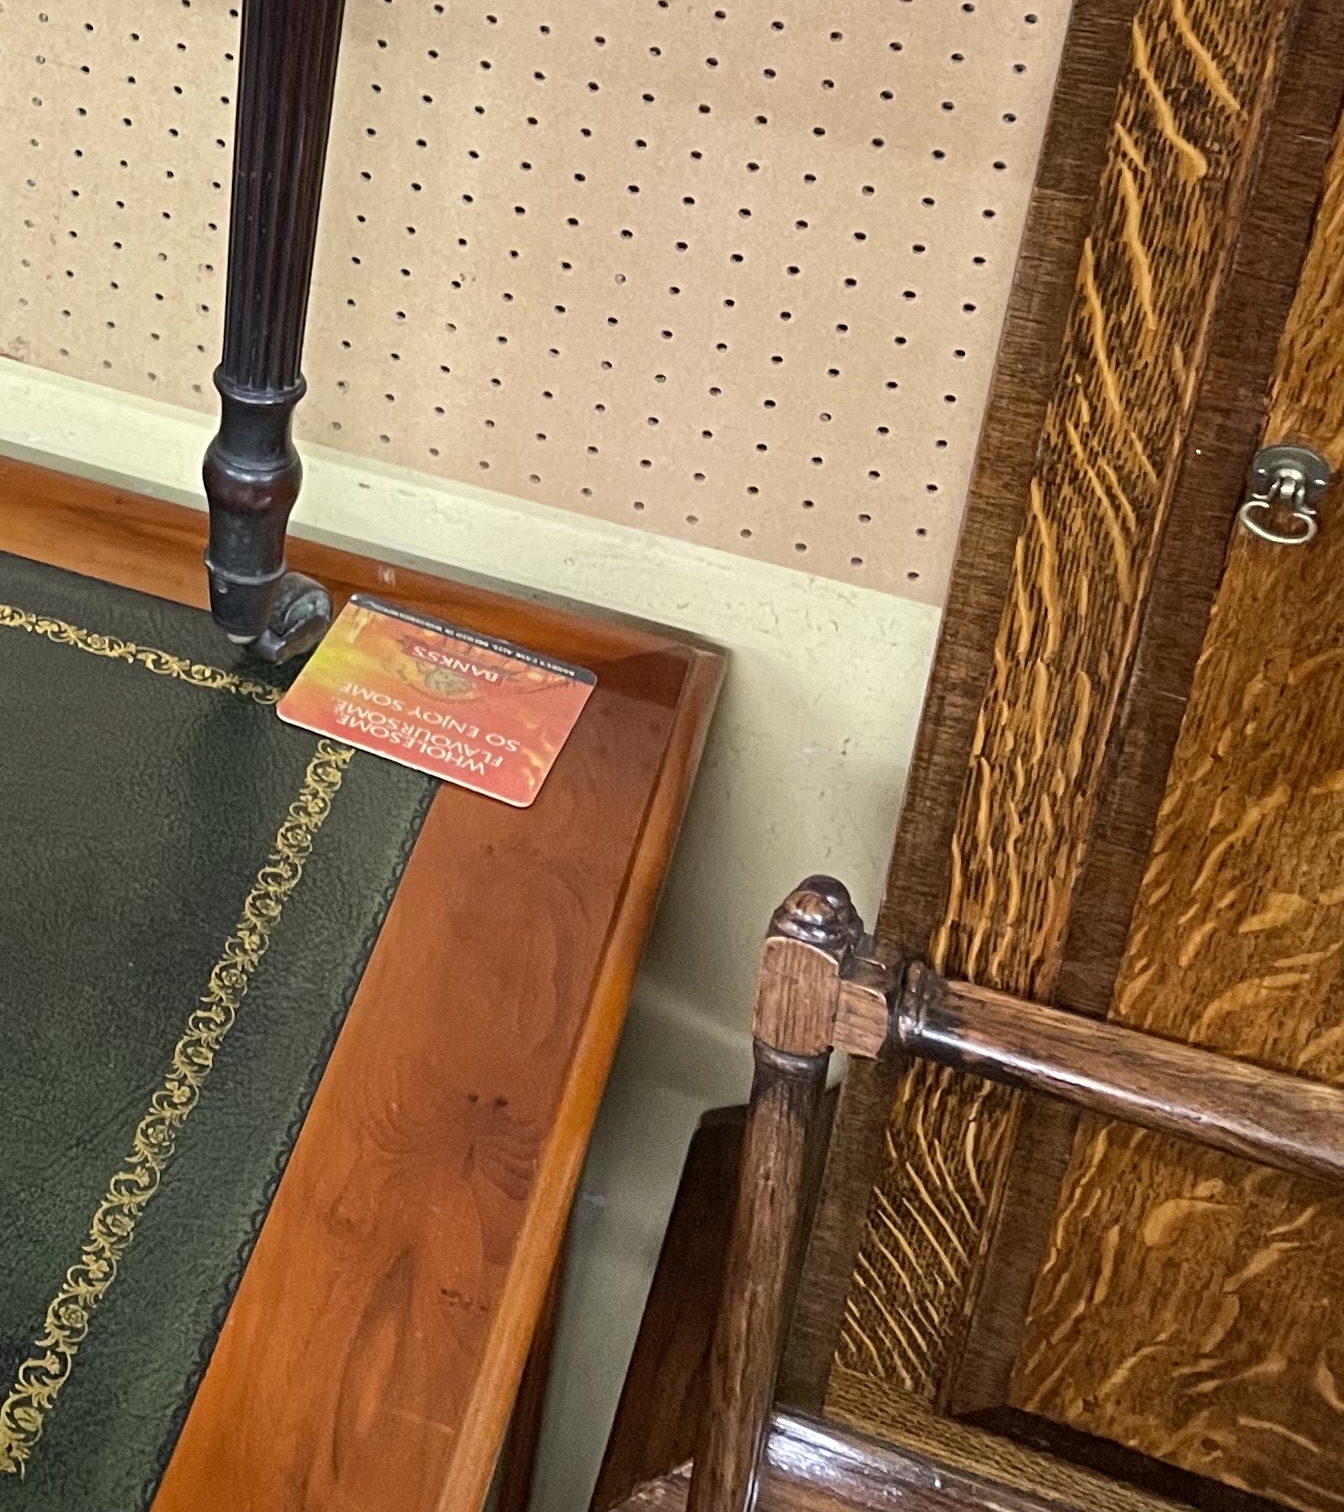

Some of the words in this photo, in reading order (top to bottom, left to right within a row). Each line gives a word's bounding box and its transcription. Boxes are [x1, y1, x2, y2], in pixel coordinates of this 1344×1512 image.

[413, 645, 500, 683] BANKS'S
[342, 681, 406, 712] SOME
[407, 706, 480, 739] ENJOY
[485, 732, 520, 752] SO
